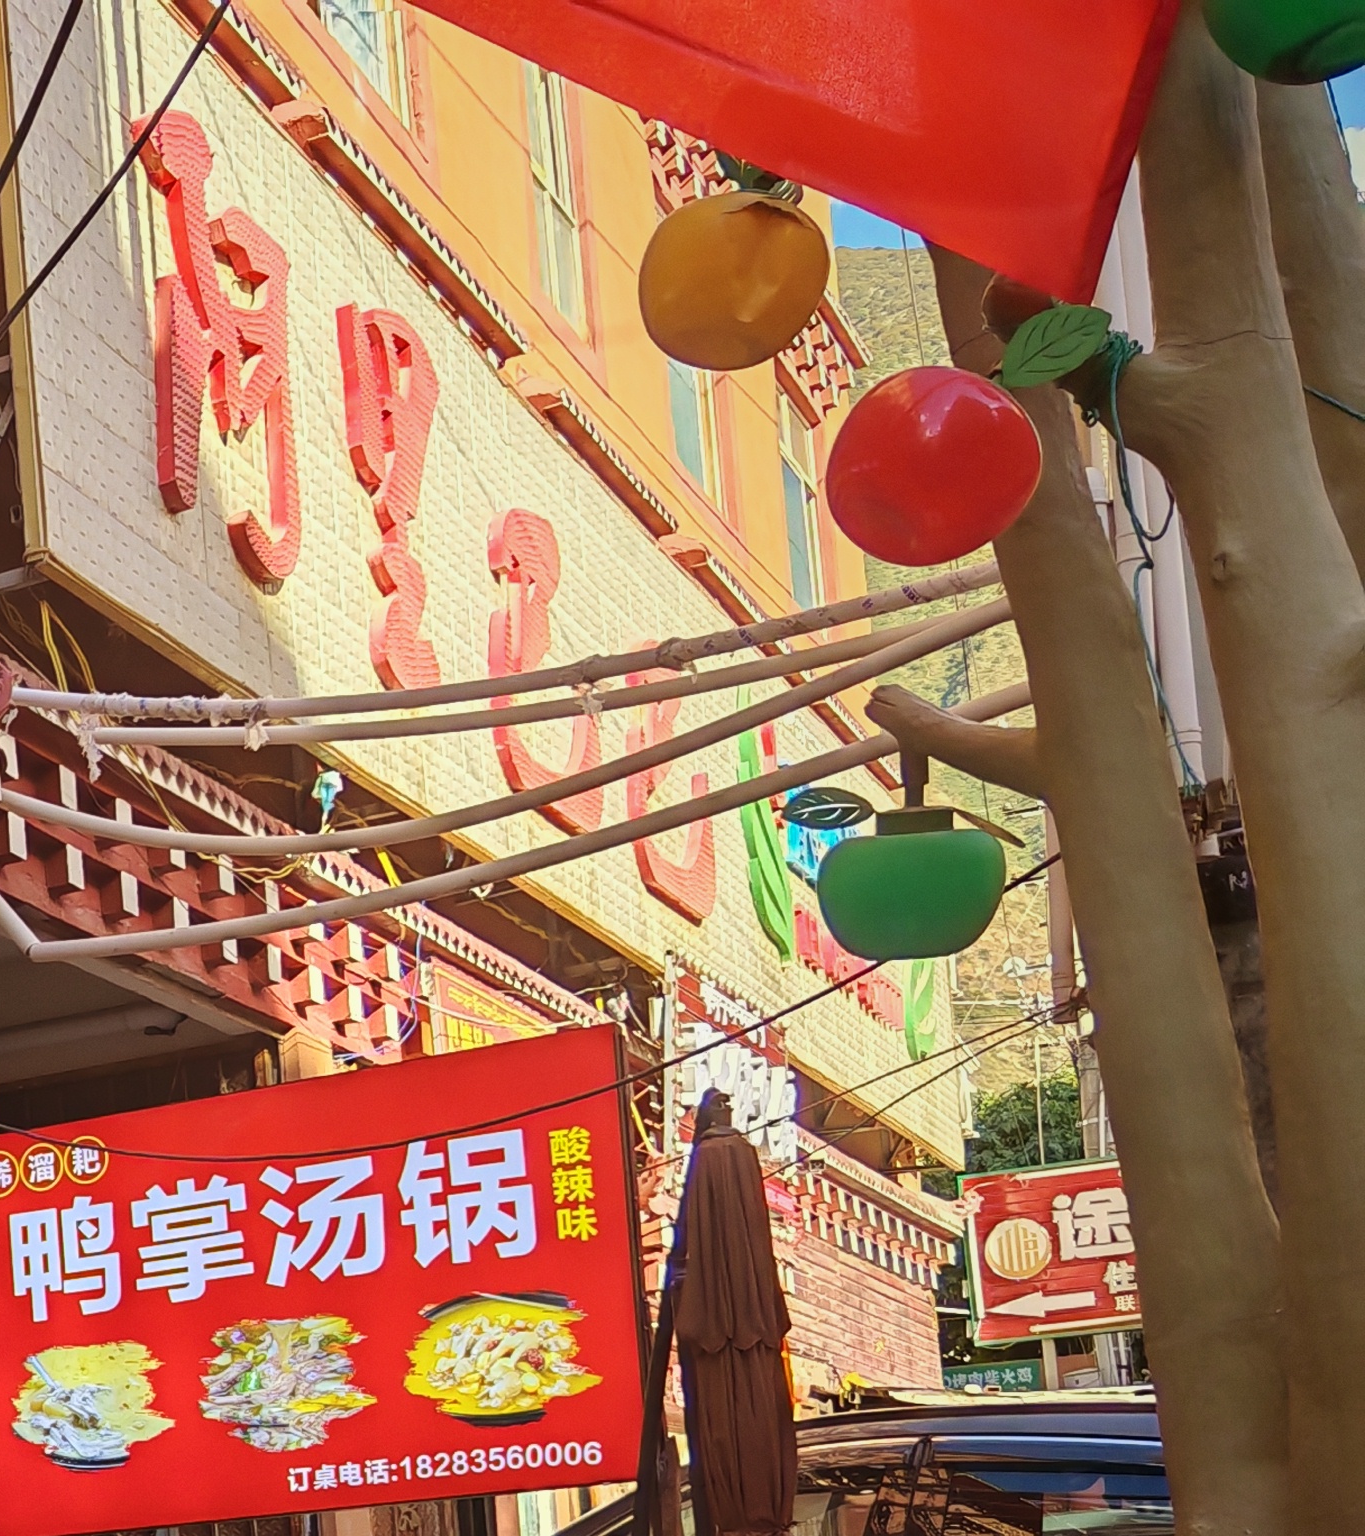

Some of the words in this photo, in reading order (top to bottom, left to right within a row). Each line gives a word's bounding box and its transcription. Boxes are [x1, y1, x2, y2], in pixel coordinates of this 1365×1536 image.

[8, 1128, 538, 1323] 鸭掌汤锅
[548, 1126, 599, 1242] 酸辣味
